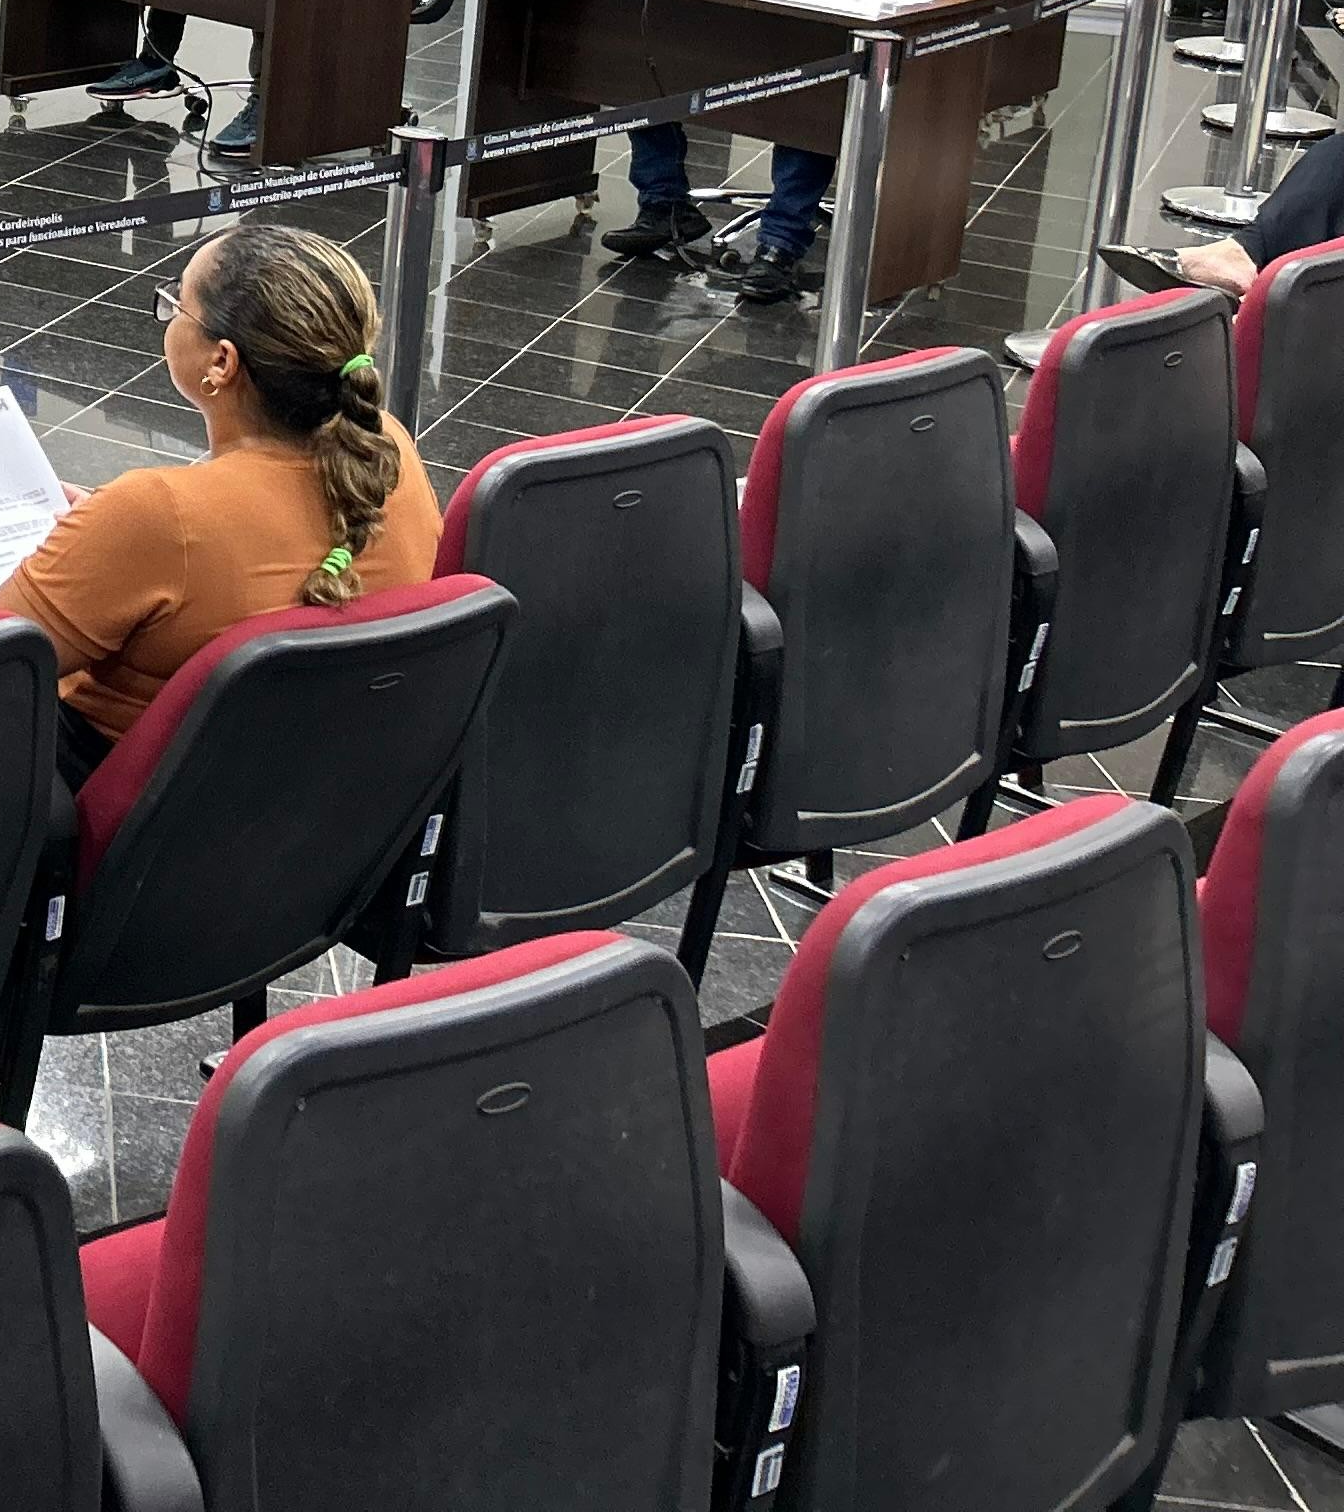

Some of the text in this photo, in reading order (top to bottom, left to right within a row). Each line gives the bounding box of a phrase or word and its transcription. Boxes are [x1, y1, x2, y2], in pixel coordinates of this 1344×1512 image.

[229, 171, 401, 209] Acesso restrito apenas para funcionários e
[231, 160, 374, 194] Câmara Municipal de Cordeirópolis
[0, 212, 63, 231] Cordeirópolis
[5, 235, 26, 248] para
[29, 225, 86, 242] funcionários
[88, 225, 93, 233] e
